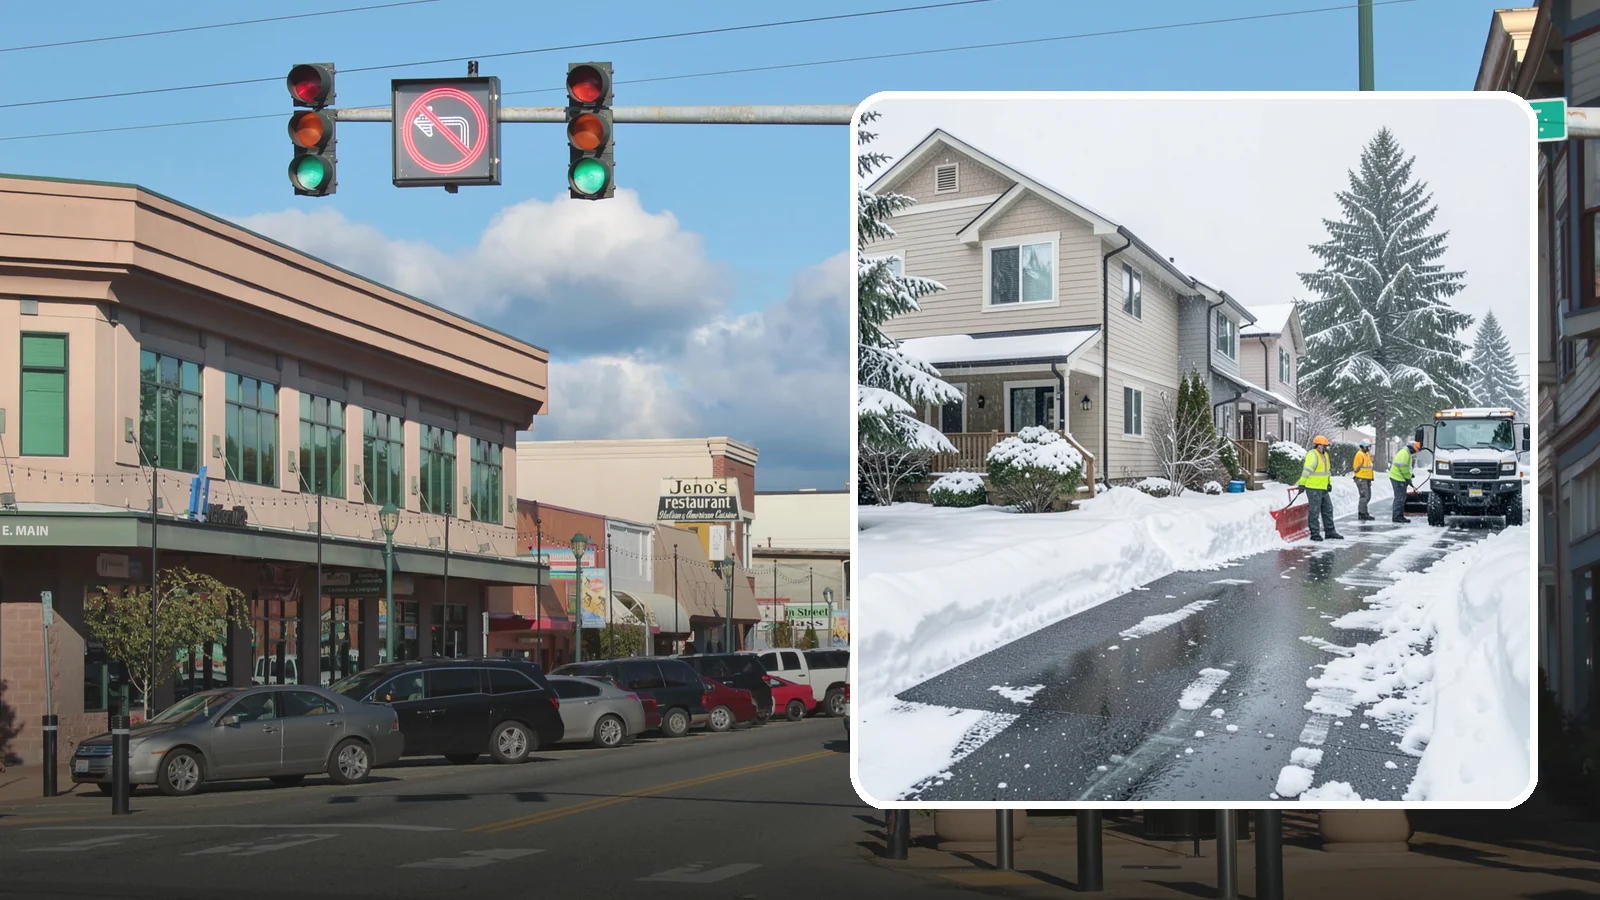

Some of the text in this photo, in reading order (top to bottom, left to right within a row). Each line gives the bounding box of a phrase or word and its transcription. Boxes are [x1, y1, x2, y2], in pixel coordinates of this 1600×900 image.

[670, 480, 727, 495] Jeno's
[665, 496, 731, 509] restaurant
[659, 510, 681, 519] Italian
[686, 509, 714, 519] American
[715, 509, 738, 519] Cuisine
[2, 525, 49, 536] E. MAIN
[797, 608, 828, 616] Street
